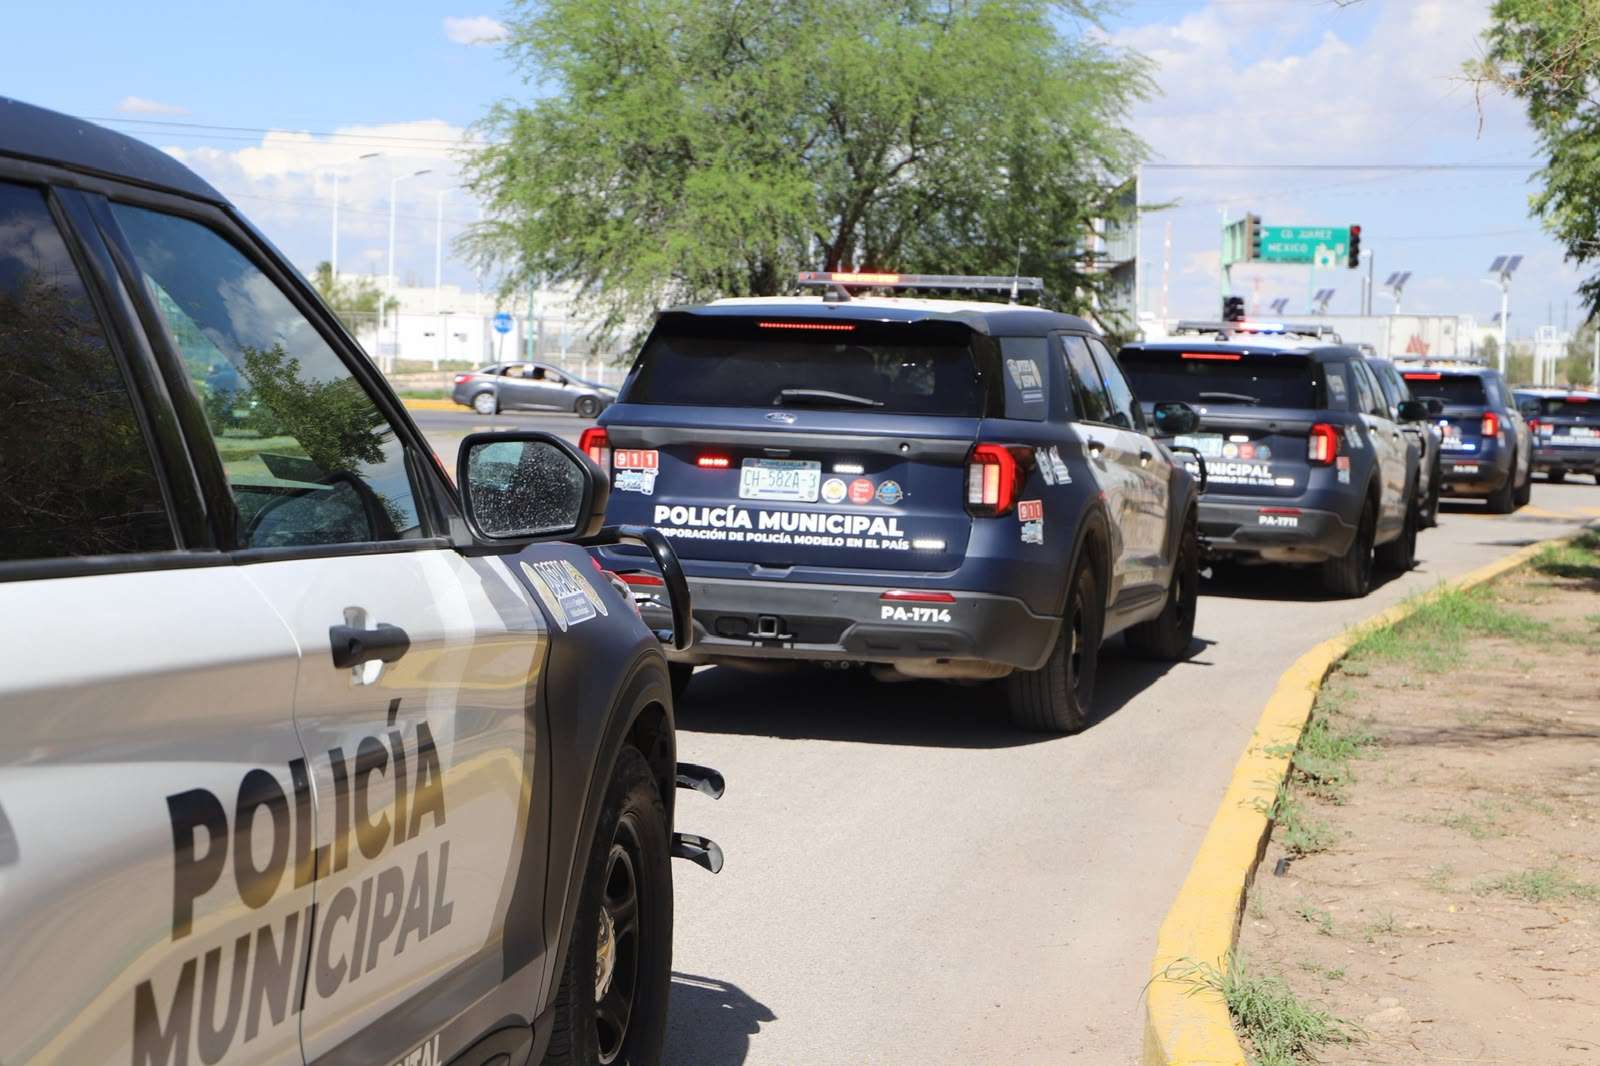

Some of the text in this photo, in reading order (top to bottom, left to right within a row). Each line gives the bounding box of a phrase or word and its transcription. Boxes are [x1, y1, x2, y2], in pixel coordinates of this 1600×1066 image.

[617, 452, 655, 467] 911
[743, 469, 817, 489] CH-582A-3
[654, 504, 904, 537] POLICÍA MUNICIPAL
[1021, 503, 1042, 519] 911
[656, 527, 910, 551] ORPORACIÓN DE POLICÍA MODELO EN EL PAÍS
[881, 605, 952, 623] PA-1714
[166, 697, 446, 943] POLICÍA
[131, 840, 454, 1066] MUNICIPAL
